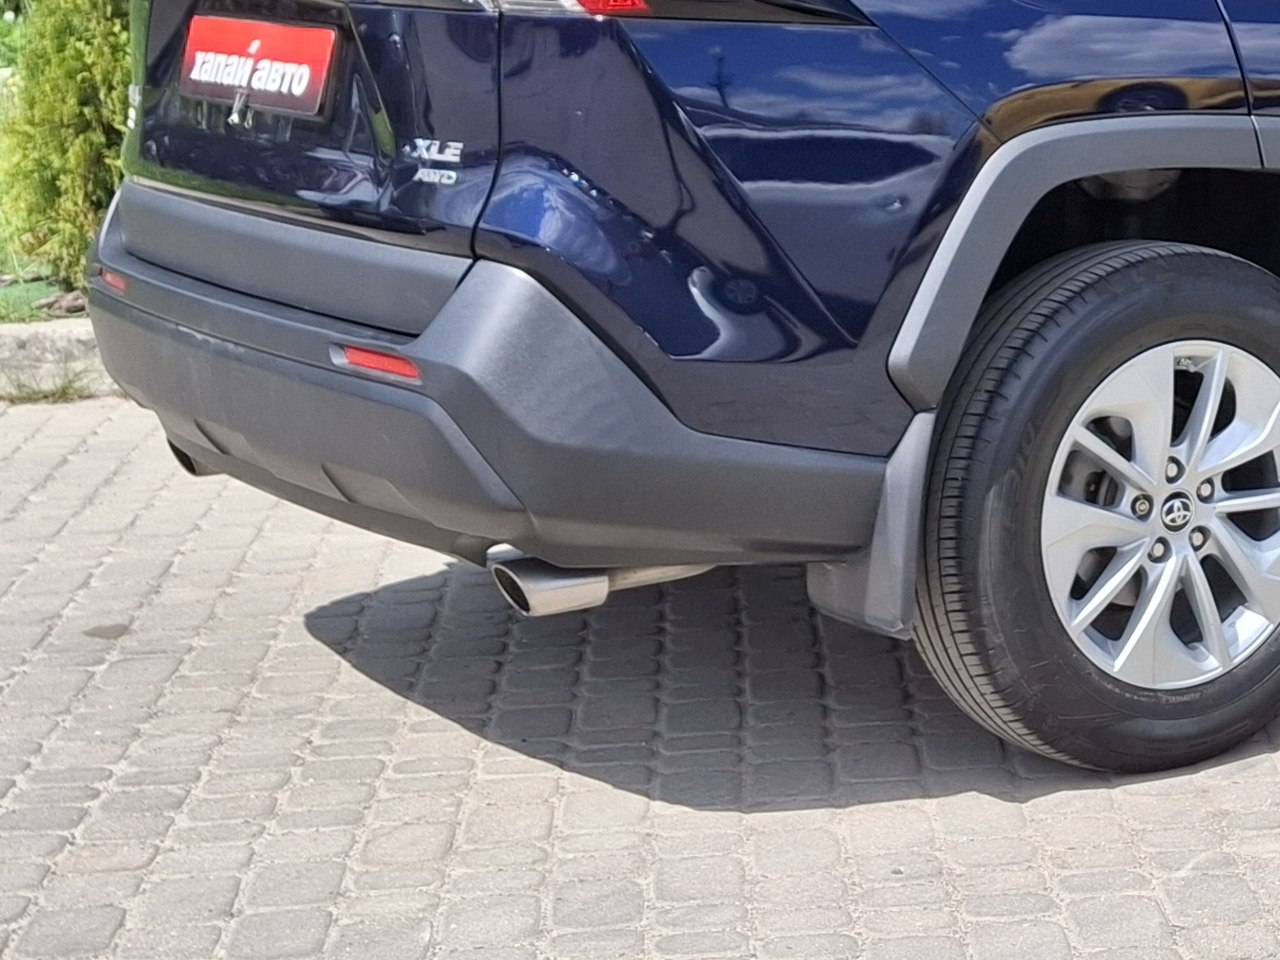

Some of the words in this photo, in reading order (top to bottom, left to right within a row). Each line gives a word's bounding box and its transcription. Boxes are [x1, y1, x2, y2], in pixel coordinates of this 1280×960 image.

[189, 39, 261, 87] хапай
[251, 58, 311, 98] авто
[411, 138, 464, 163] XLE
